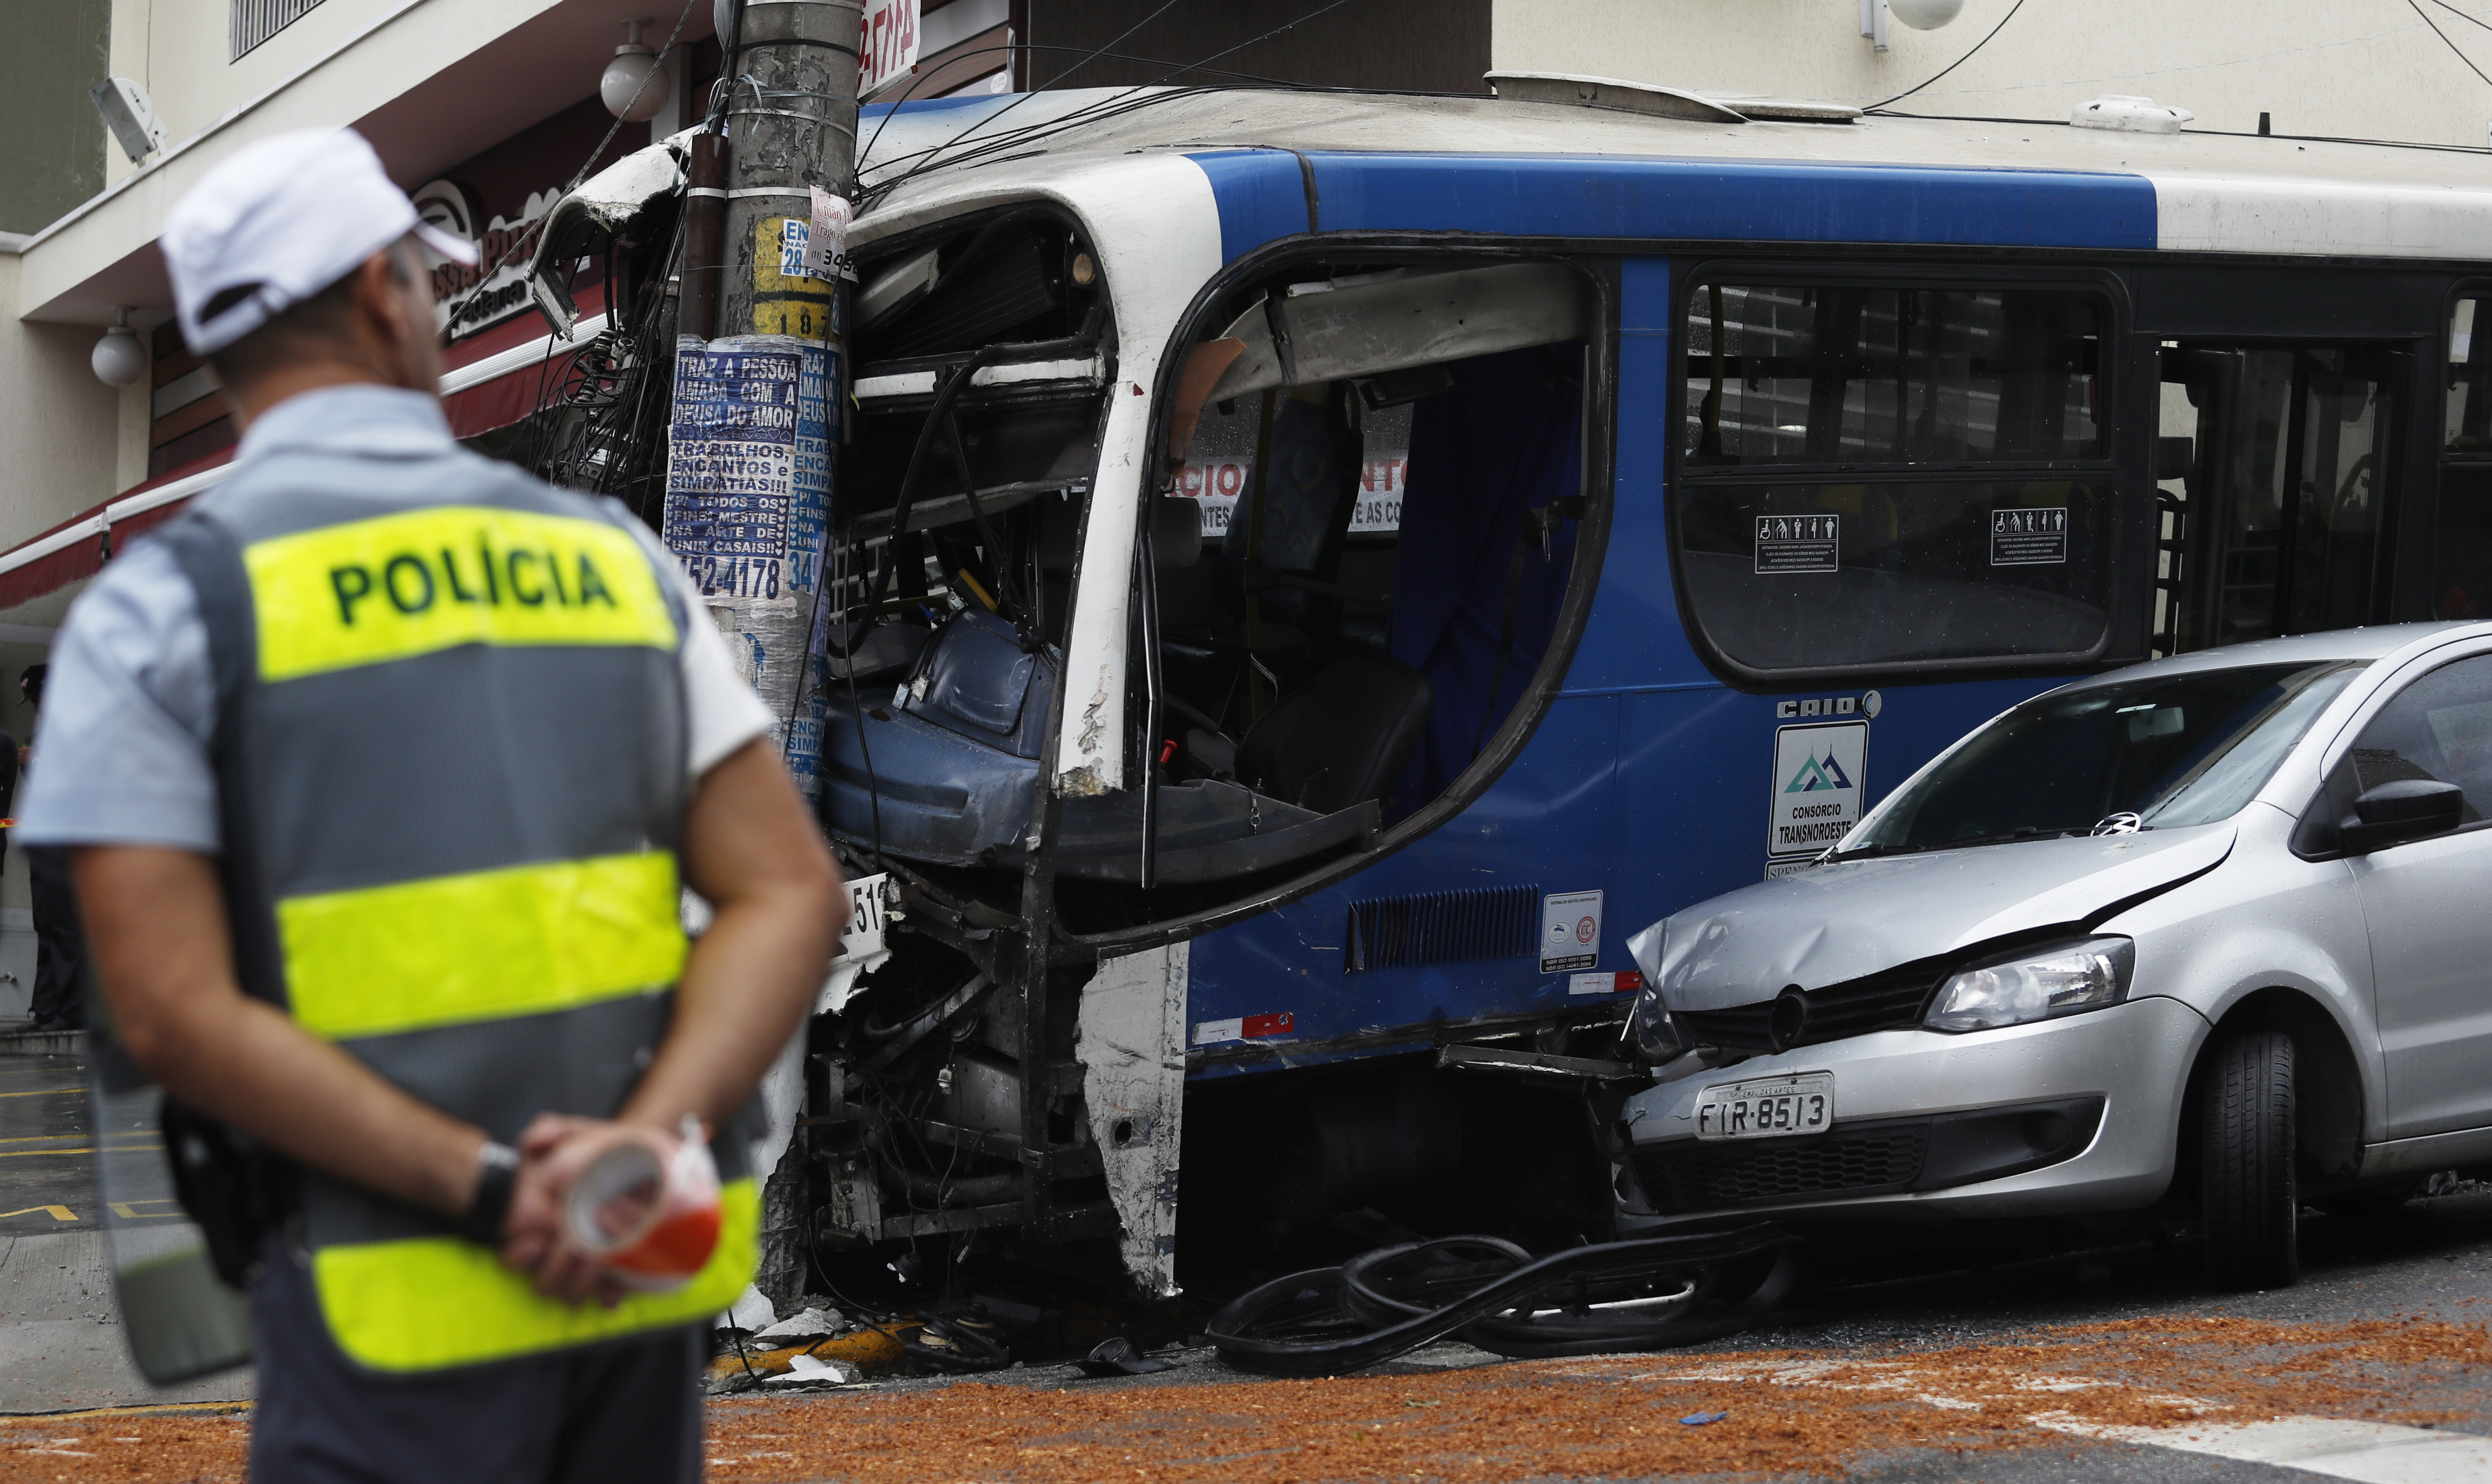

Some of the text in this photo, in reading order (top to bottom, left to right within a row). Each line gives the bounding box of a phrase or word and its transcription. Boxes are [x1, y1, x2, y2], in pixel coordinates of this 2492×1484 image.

[815, 196, 842, 222] União
[814, 220, 836, 241] Trago
[812, 250, 821, 262] (11)
[680, 357, 797, 382] TRAZ A PESSOA
[677, 380, 795, 406] AMADA COM A
[676, 404, 793, 429] DEUSA DO AMOR
[673, 443, 789, 462] TRABALHOS,
[671, 460, 788, 476] ENCANTOS e
[670, 475, 786, 492] SIMPATIAS!!!
[699, 497, 748, 507] TODOS
[759, 497, 778, 510] OS
[1366, 501, 1382, 523] AS
[719, 512, 777, 524] MESTRE
[799, 506, 826, 521] FINS!
[673, 526, 776, 538] NA ARTE DE
[798, 521, 815, 534] NA
[672, 541, 774, 553] UNIR CASAIS!!
[330, 528, 616, 627] POLÍCIA
[1777, 697, 1855, 718] CAIO
[1792, 802, 1841, 819] CONSÓRCIO
